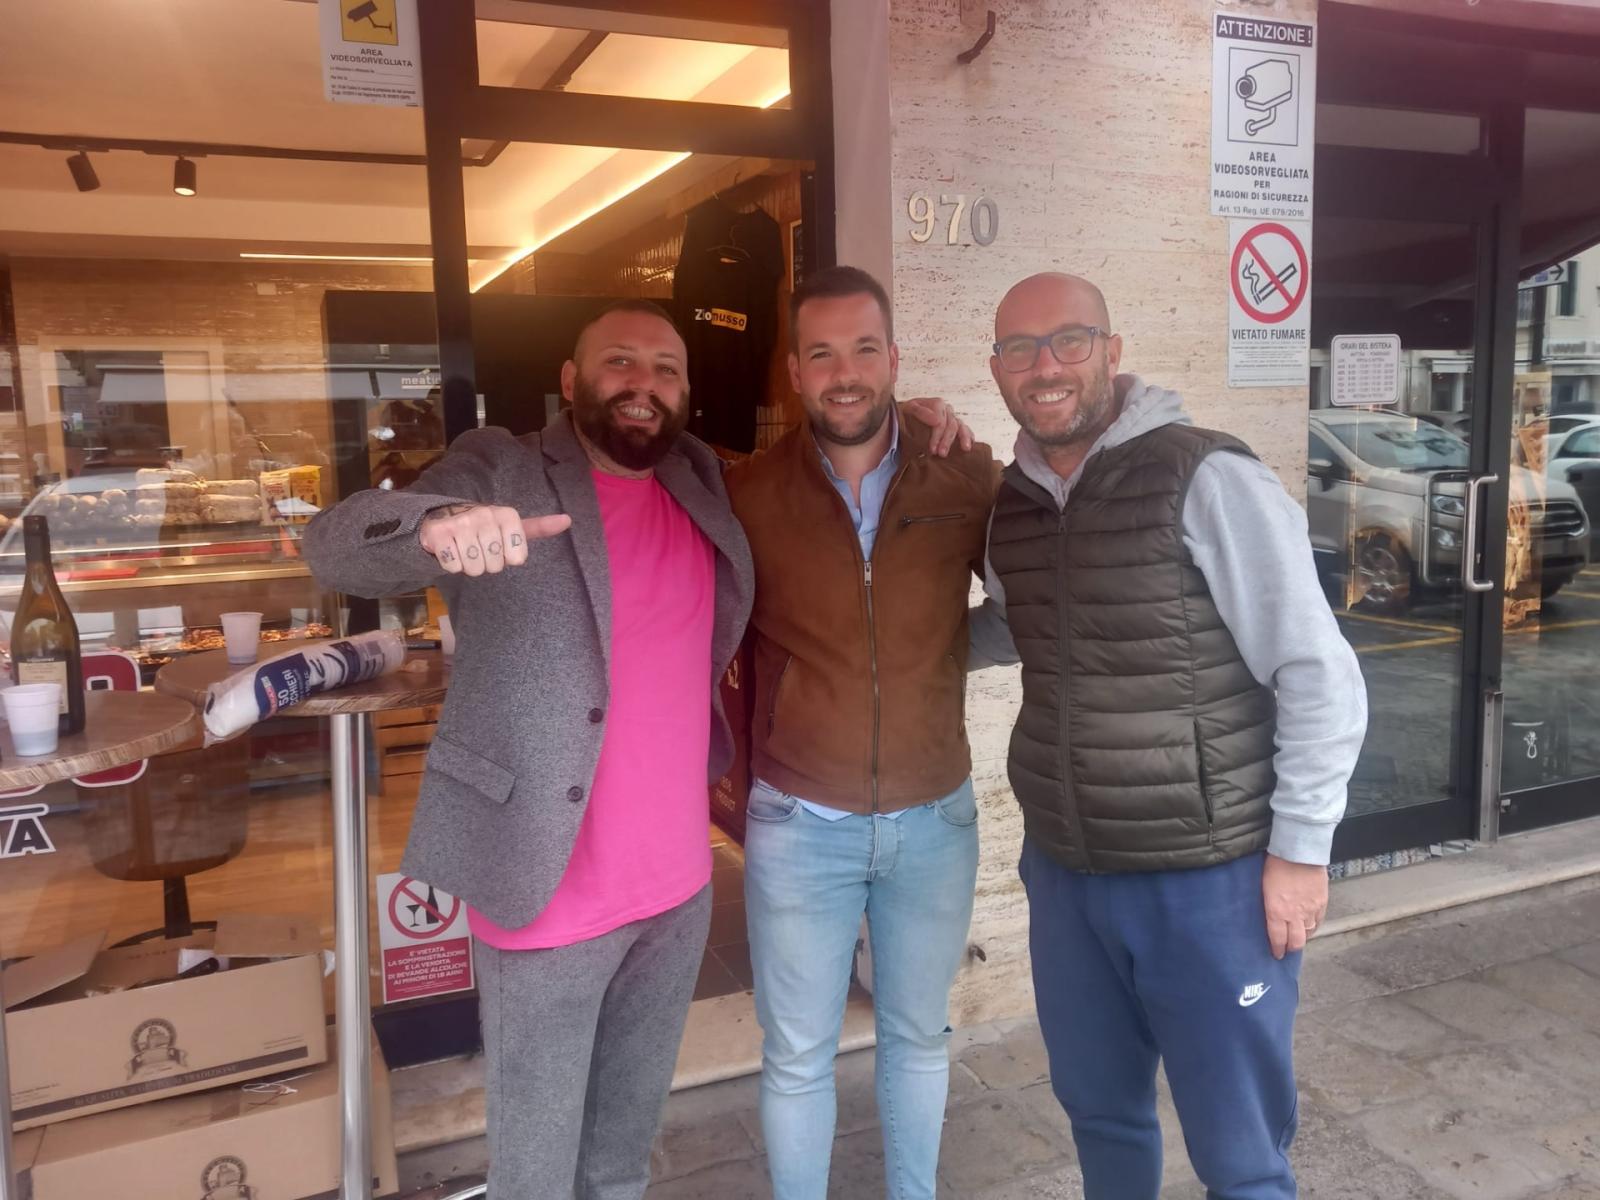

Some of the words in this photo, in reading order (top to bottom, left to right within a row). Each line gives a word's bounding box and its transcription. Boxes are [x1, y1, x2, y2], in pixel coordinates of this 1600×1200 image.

[360, 48, 383, 57] AREA
[330, 54, 413, 68] VIDEOSORVEGLIATA
[1249, 151, 1276, 163] AREA
[1214, 163, 1309, 179] VIDEOSORVEGLIATA
[1254, 180, 1271, 189] PER
[1213, 189, 1249, 200] RAGIONI
[1251, 191, 1260, 200] DI
[1261, 192, 1309, 203] SICUREZZA
[907, 190, 999, 247] 970
[1231, 329, 1268, 340] VIETATO
[1270, 328, 1306, 340] FUMARE
[277, 688, 290, 708] 50
[1243, 982, 1265, 999] NIKE
